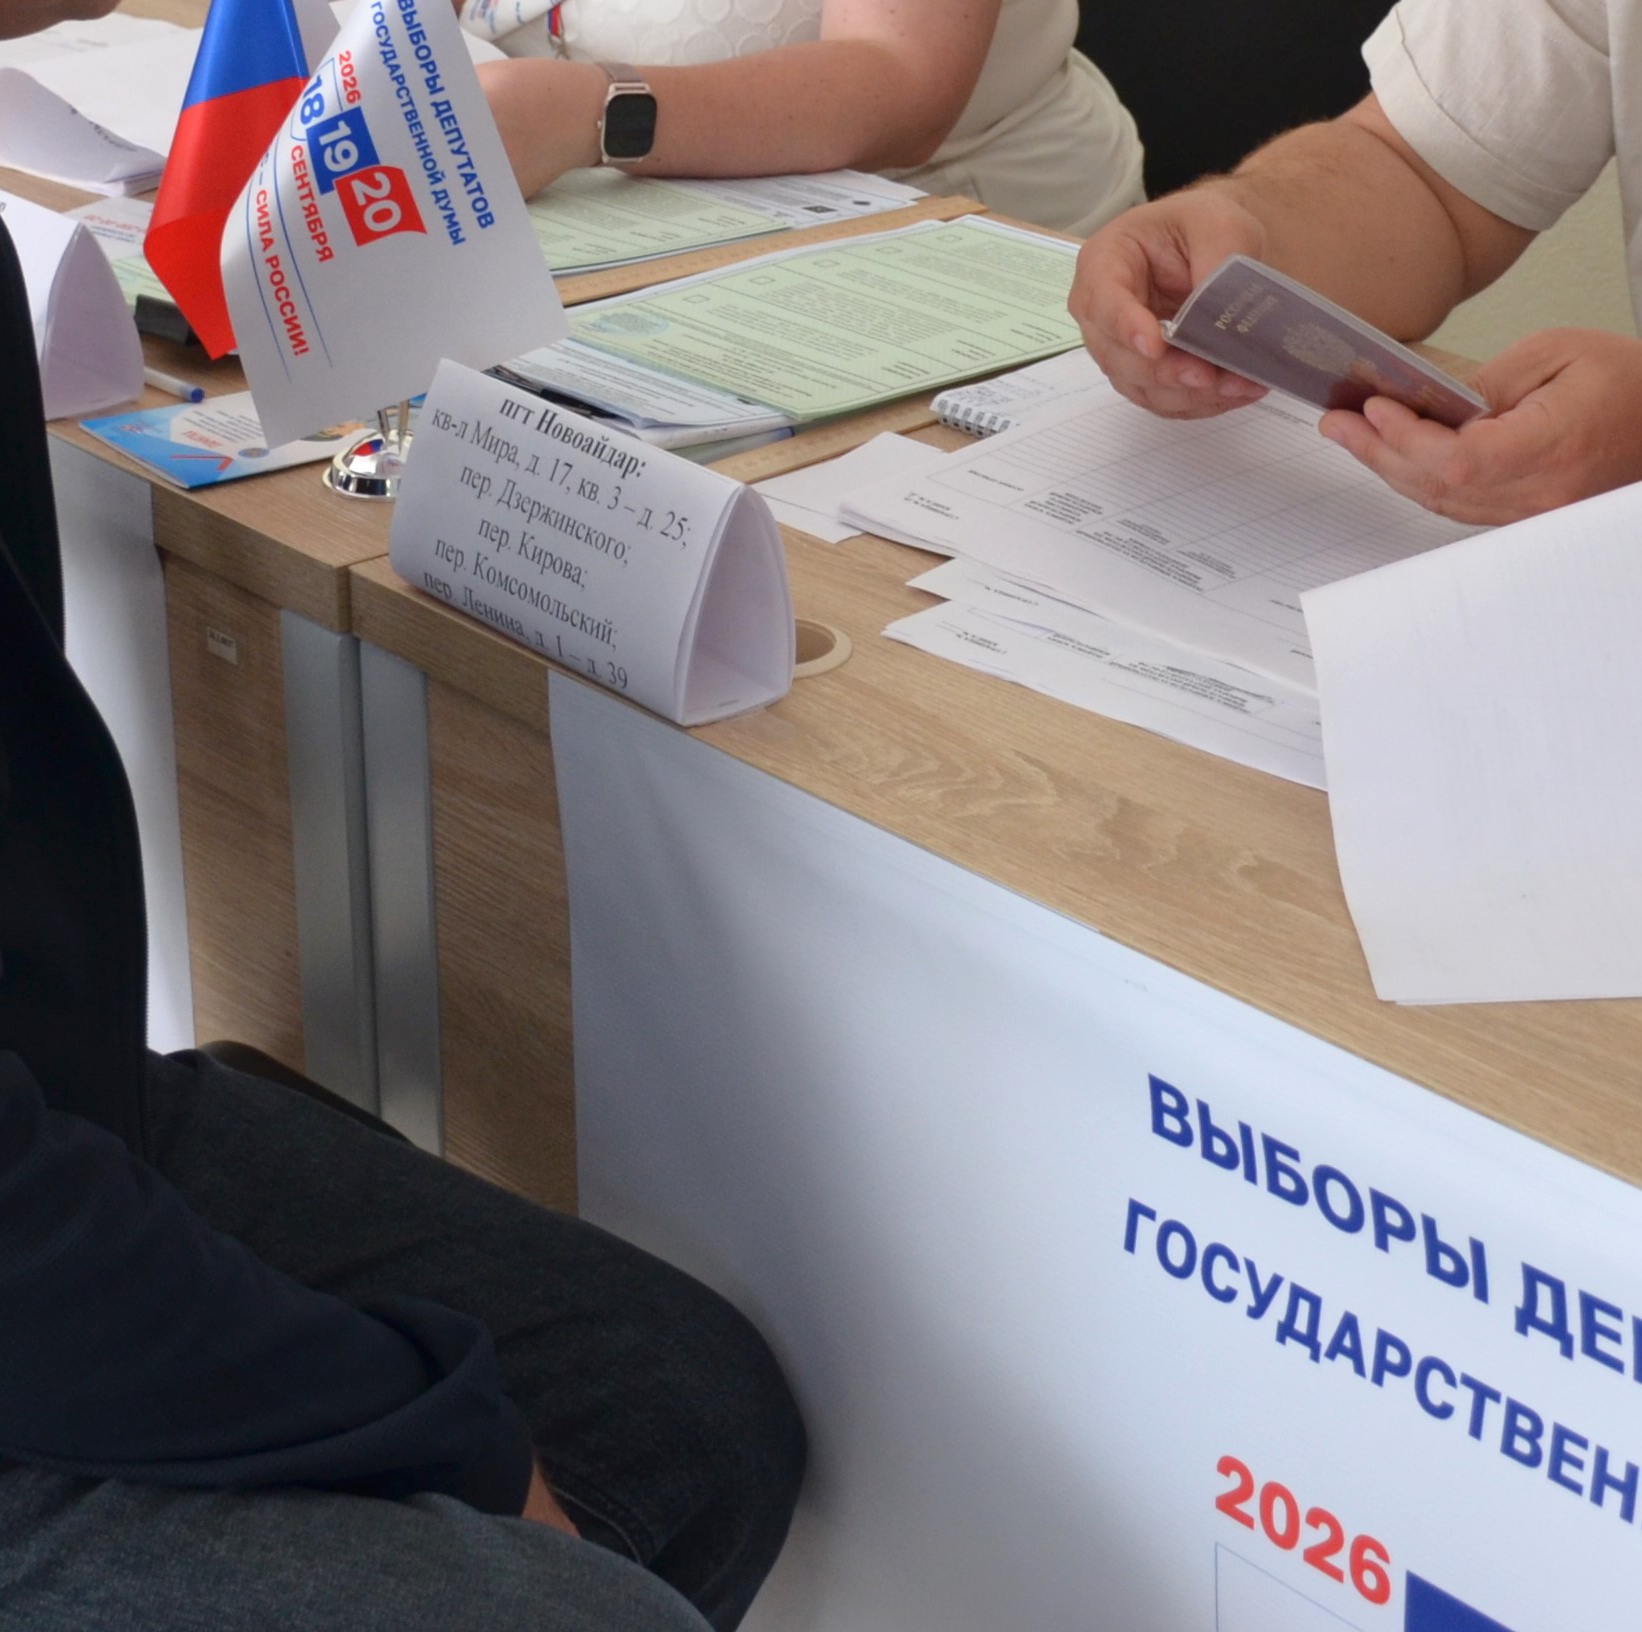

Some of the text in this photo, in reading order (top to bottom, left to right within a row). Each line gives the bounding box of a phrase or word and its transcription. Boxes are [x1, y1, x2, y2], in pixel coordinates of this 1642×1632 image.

[299, 73, 325, 126] 18
[338, 50, 362, 105] 2026
[370, 1, 466, 246] ГОСУДАРСТВЕННОЙ ДУМЫ
[318, 120, 359, 173] 19
[430, 100, 495, 229] ДЕПУТАТОВ
[255, 189, 275, 252] СИЛА
[290, 145, 335, 263] СЕНТЯБРЯ
[350, 171, 402, 232] 20
[264, 255, 310, 356] РОССИИ!
[431, 408, 469, 440] кв-л
[470, 421, 520, 468] Мира,
[525, 452, 541, 476] д.
[549, 458, 574, 495] 17,
[577, 478, 600, 505] кв.
[607, 485, 620, 511] 3
[637, 506, 654, 530] д.
[660, 511, 691, 550] 25;
[499, 399, 647, 480] пгт Новоайдар:
[459, 465, 632, 567] пер. Дзержинского;
[478, 519, 588, 592] пер. Кирова;
[423, 572, 456, 602] пер.
[607, 662, 629, 690] 39
[435, 539, 617, 652] пер. Комсомольский;
[1147, 1072, 1490, 1304] ВЫБОРЫ
[1214, 1455, 1392, 1606] 2026
